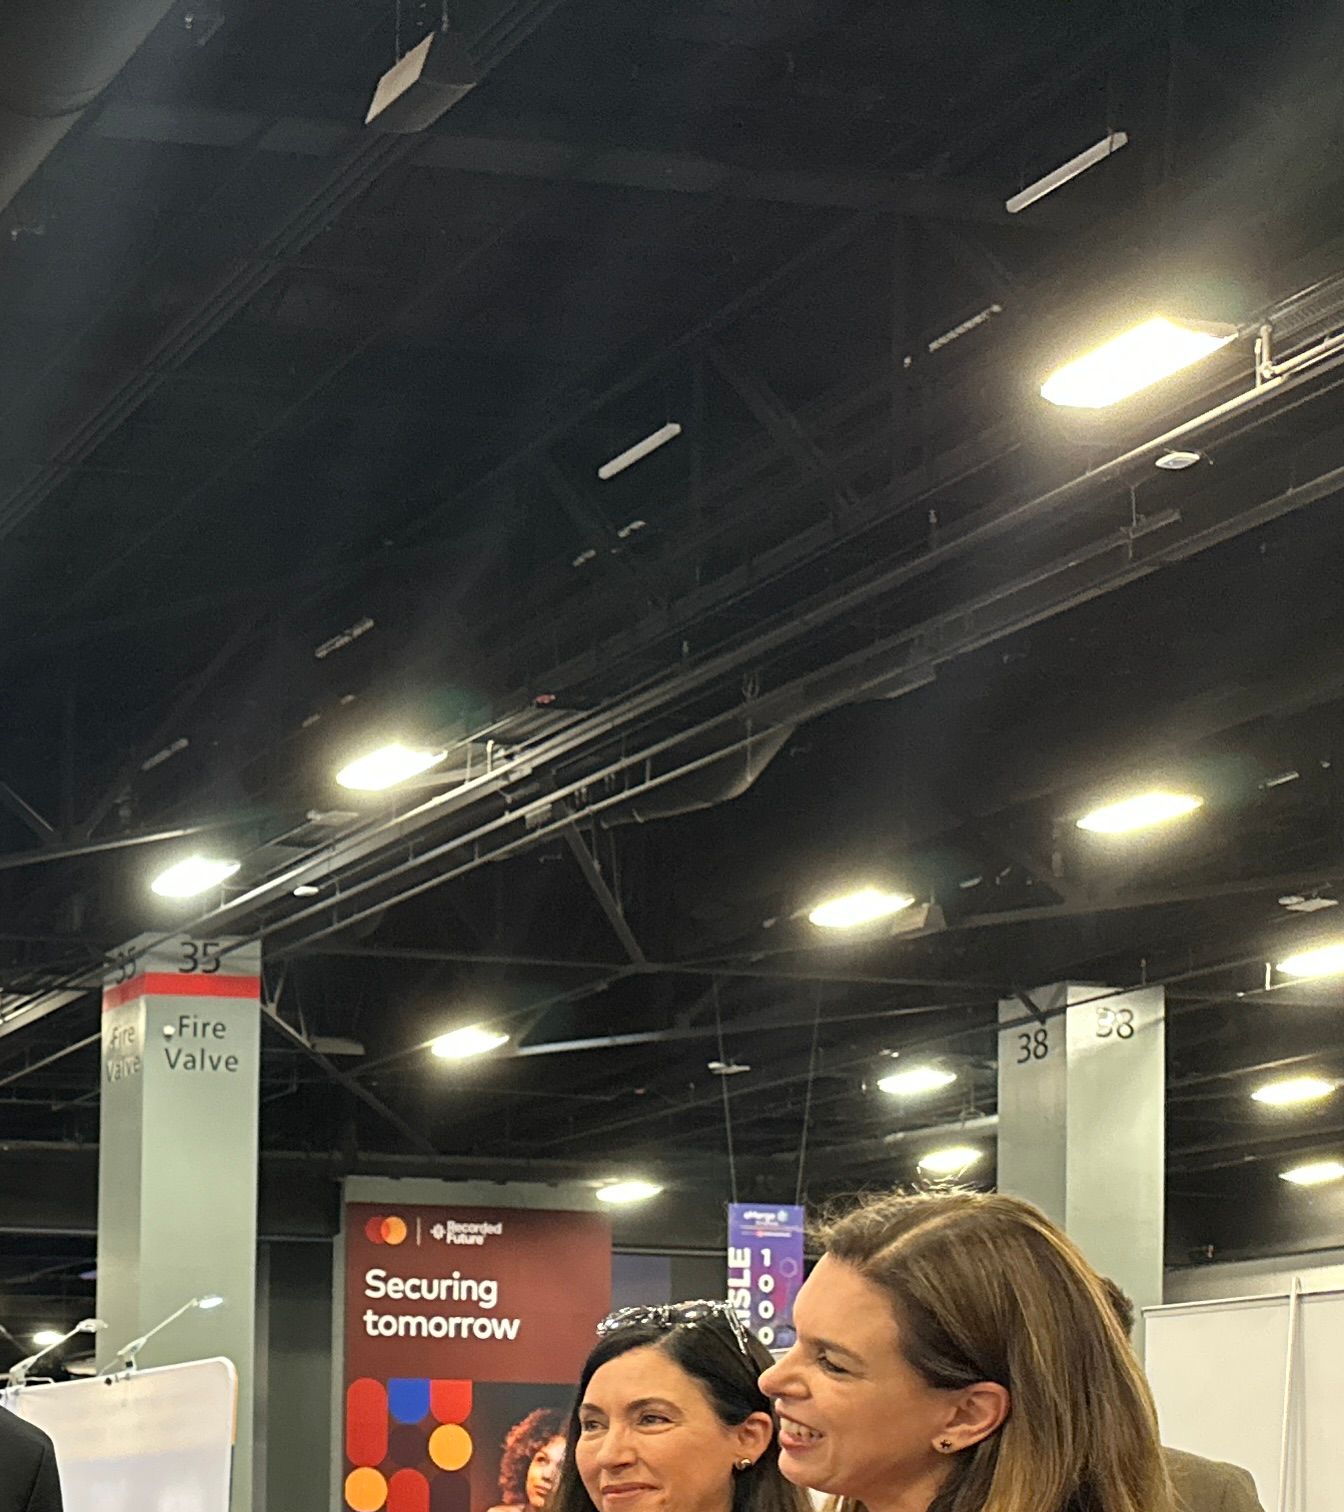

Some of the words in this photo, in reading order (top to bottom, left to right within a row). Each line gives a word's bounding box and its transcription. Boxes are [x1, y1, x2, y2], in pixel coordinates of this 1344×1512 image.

[178, 942, 221, 974] 35
[178, 1014, 226, 1039] Fire
[165, 1047, 239, 1073] Valve
[1017, 1028, 1048, 1064] 38
[446, 1220, 503, 1236] Recorded
[446, 1233, 485, 1246] Future
[364, 1268, 498, 1309] Securing
[727, 1247, 752, 1329] ISLE
[363, 1309, 521, 1340] tomorrow
